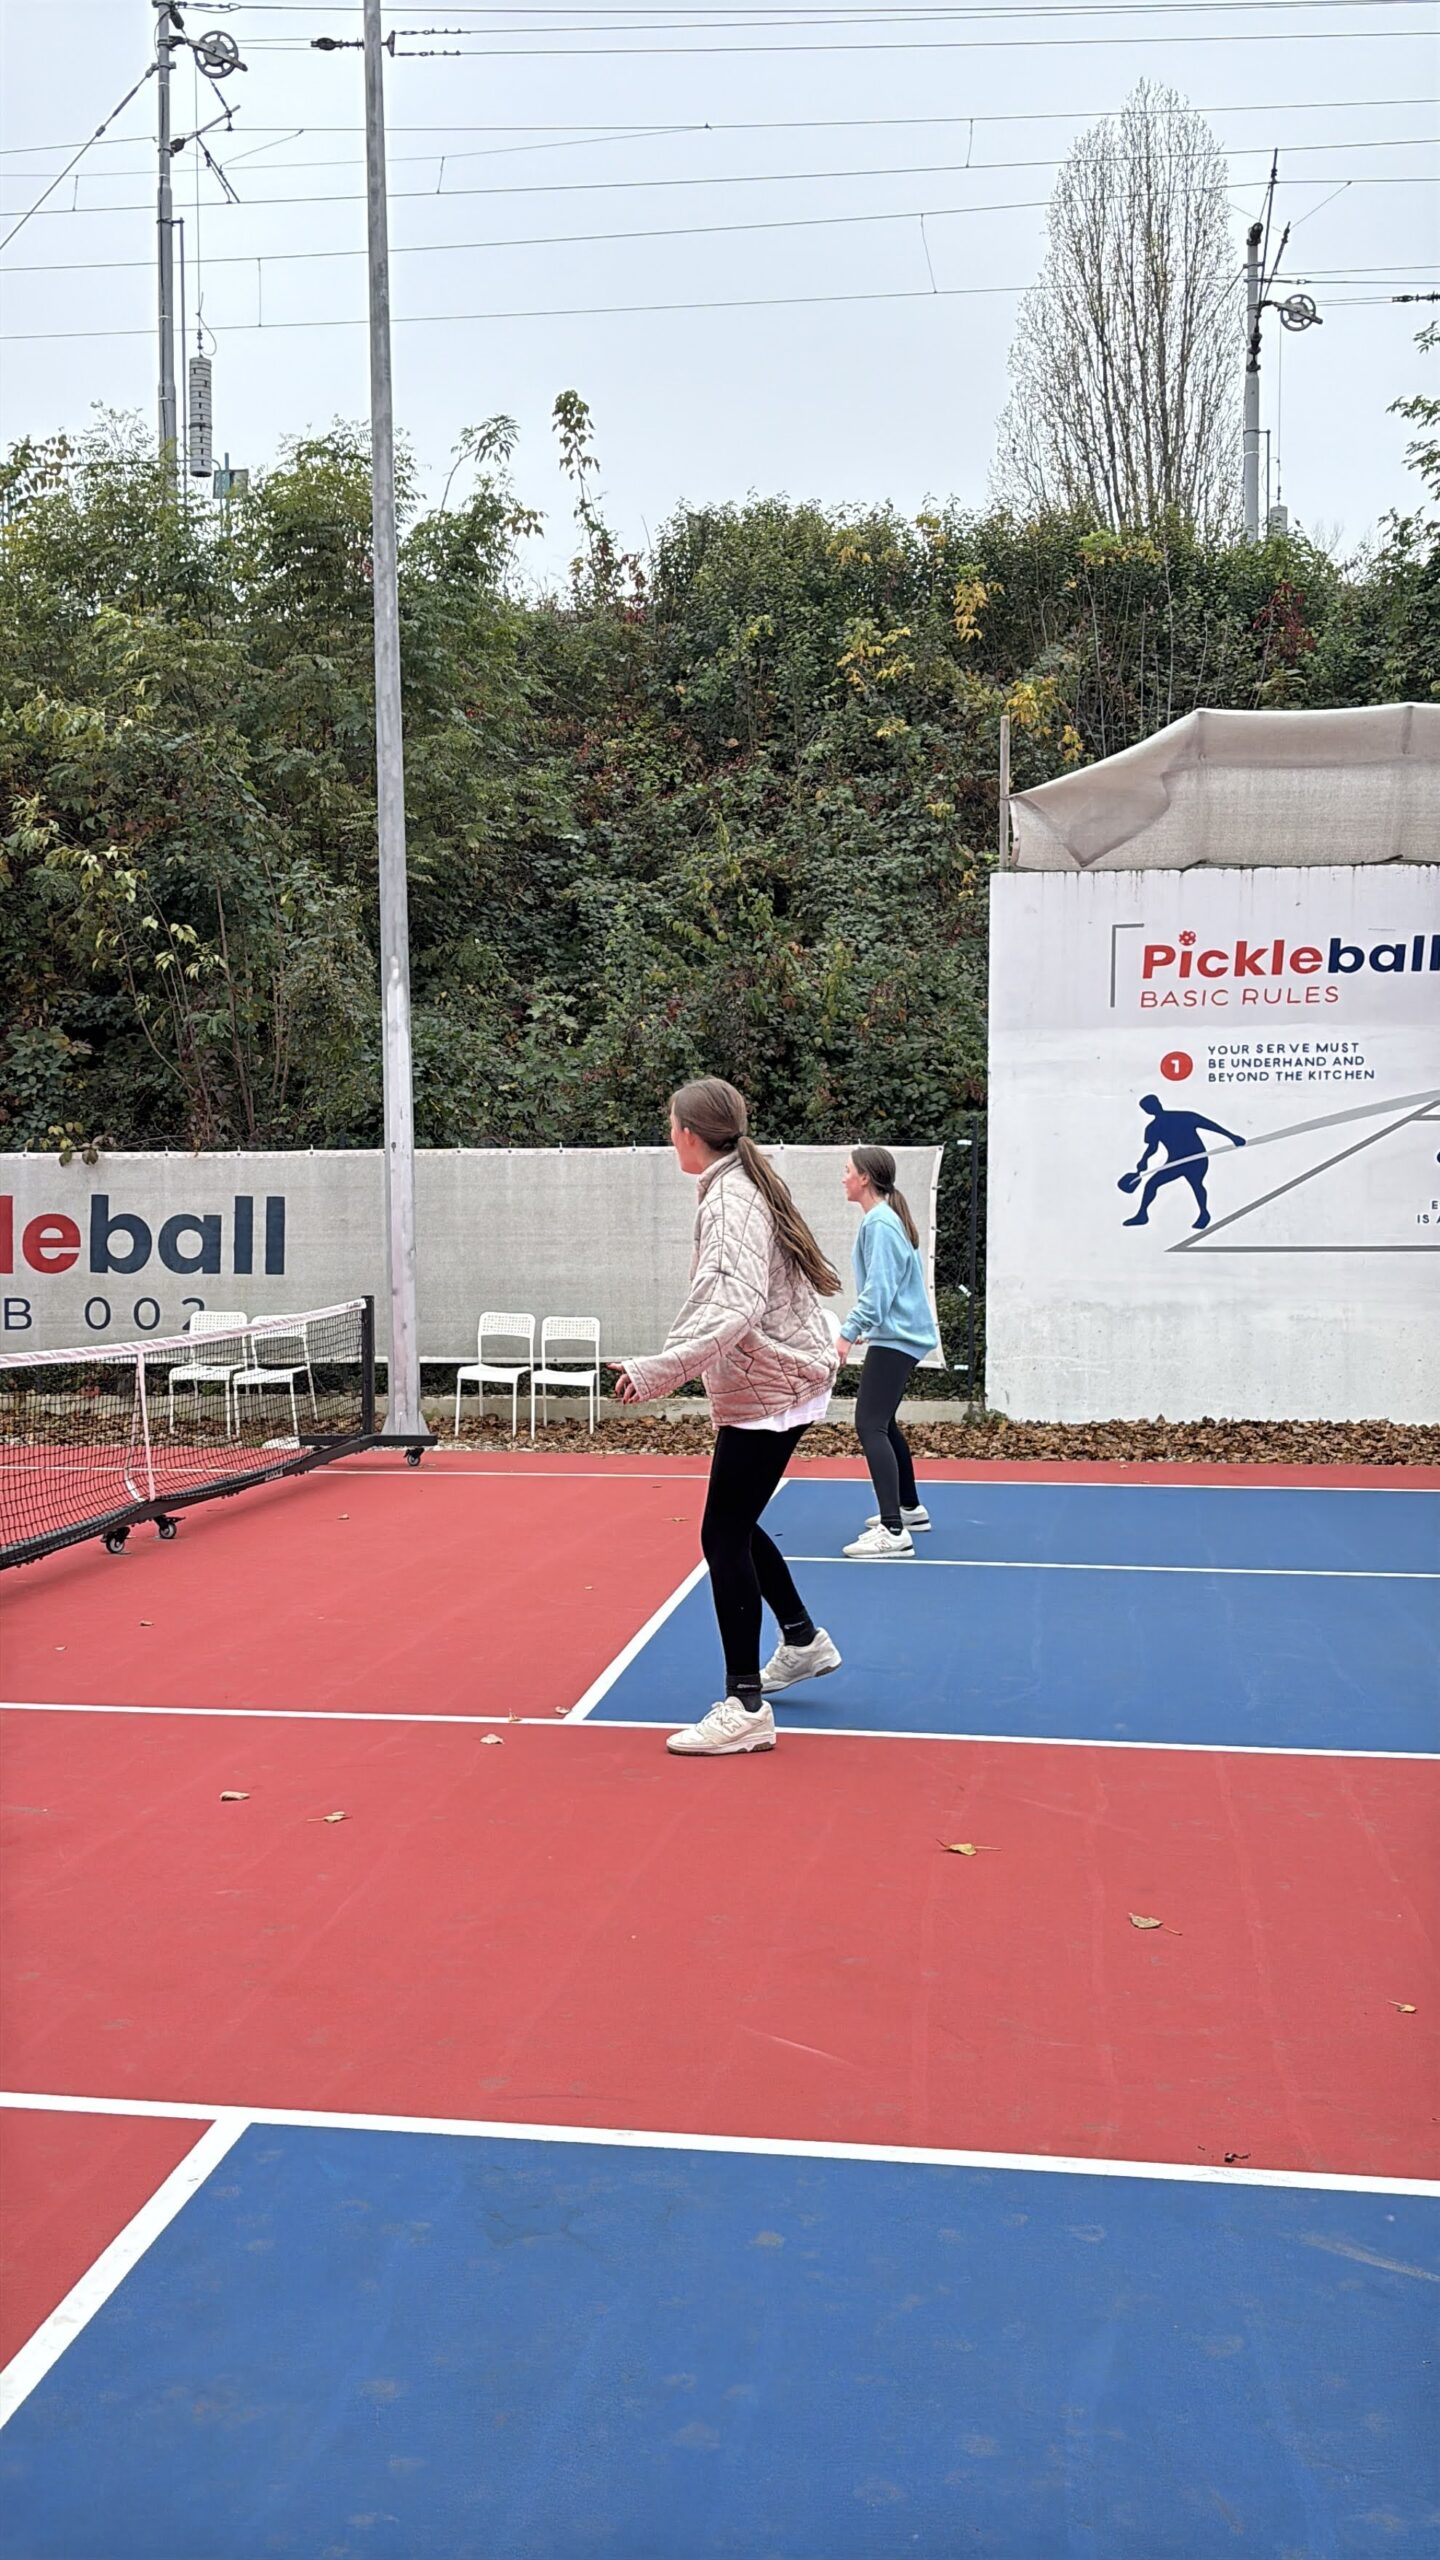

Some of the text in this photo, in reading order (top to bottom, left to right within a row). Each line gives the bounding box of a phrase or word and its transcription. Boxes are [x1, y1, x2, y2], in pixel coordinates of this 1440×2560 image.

[1142, 930, 1440, 979] Pickleball
[1140, 985, 1339, 1008] BASIC RULES
[1208, 1042, 1359, 1055] YOUR SERVE MUST
[1171, 1060, 1180, 1073] 1
[1208, 1056, 1364, 1068] BE UNDERHAND AND
[1208, 1070, 1375, 1082] BEYOND THE KITCHEN
[1417, 1214, 1430, 1224] IS
[4, 1297, 32, 1330] B
